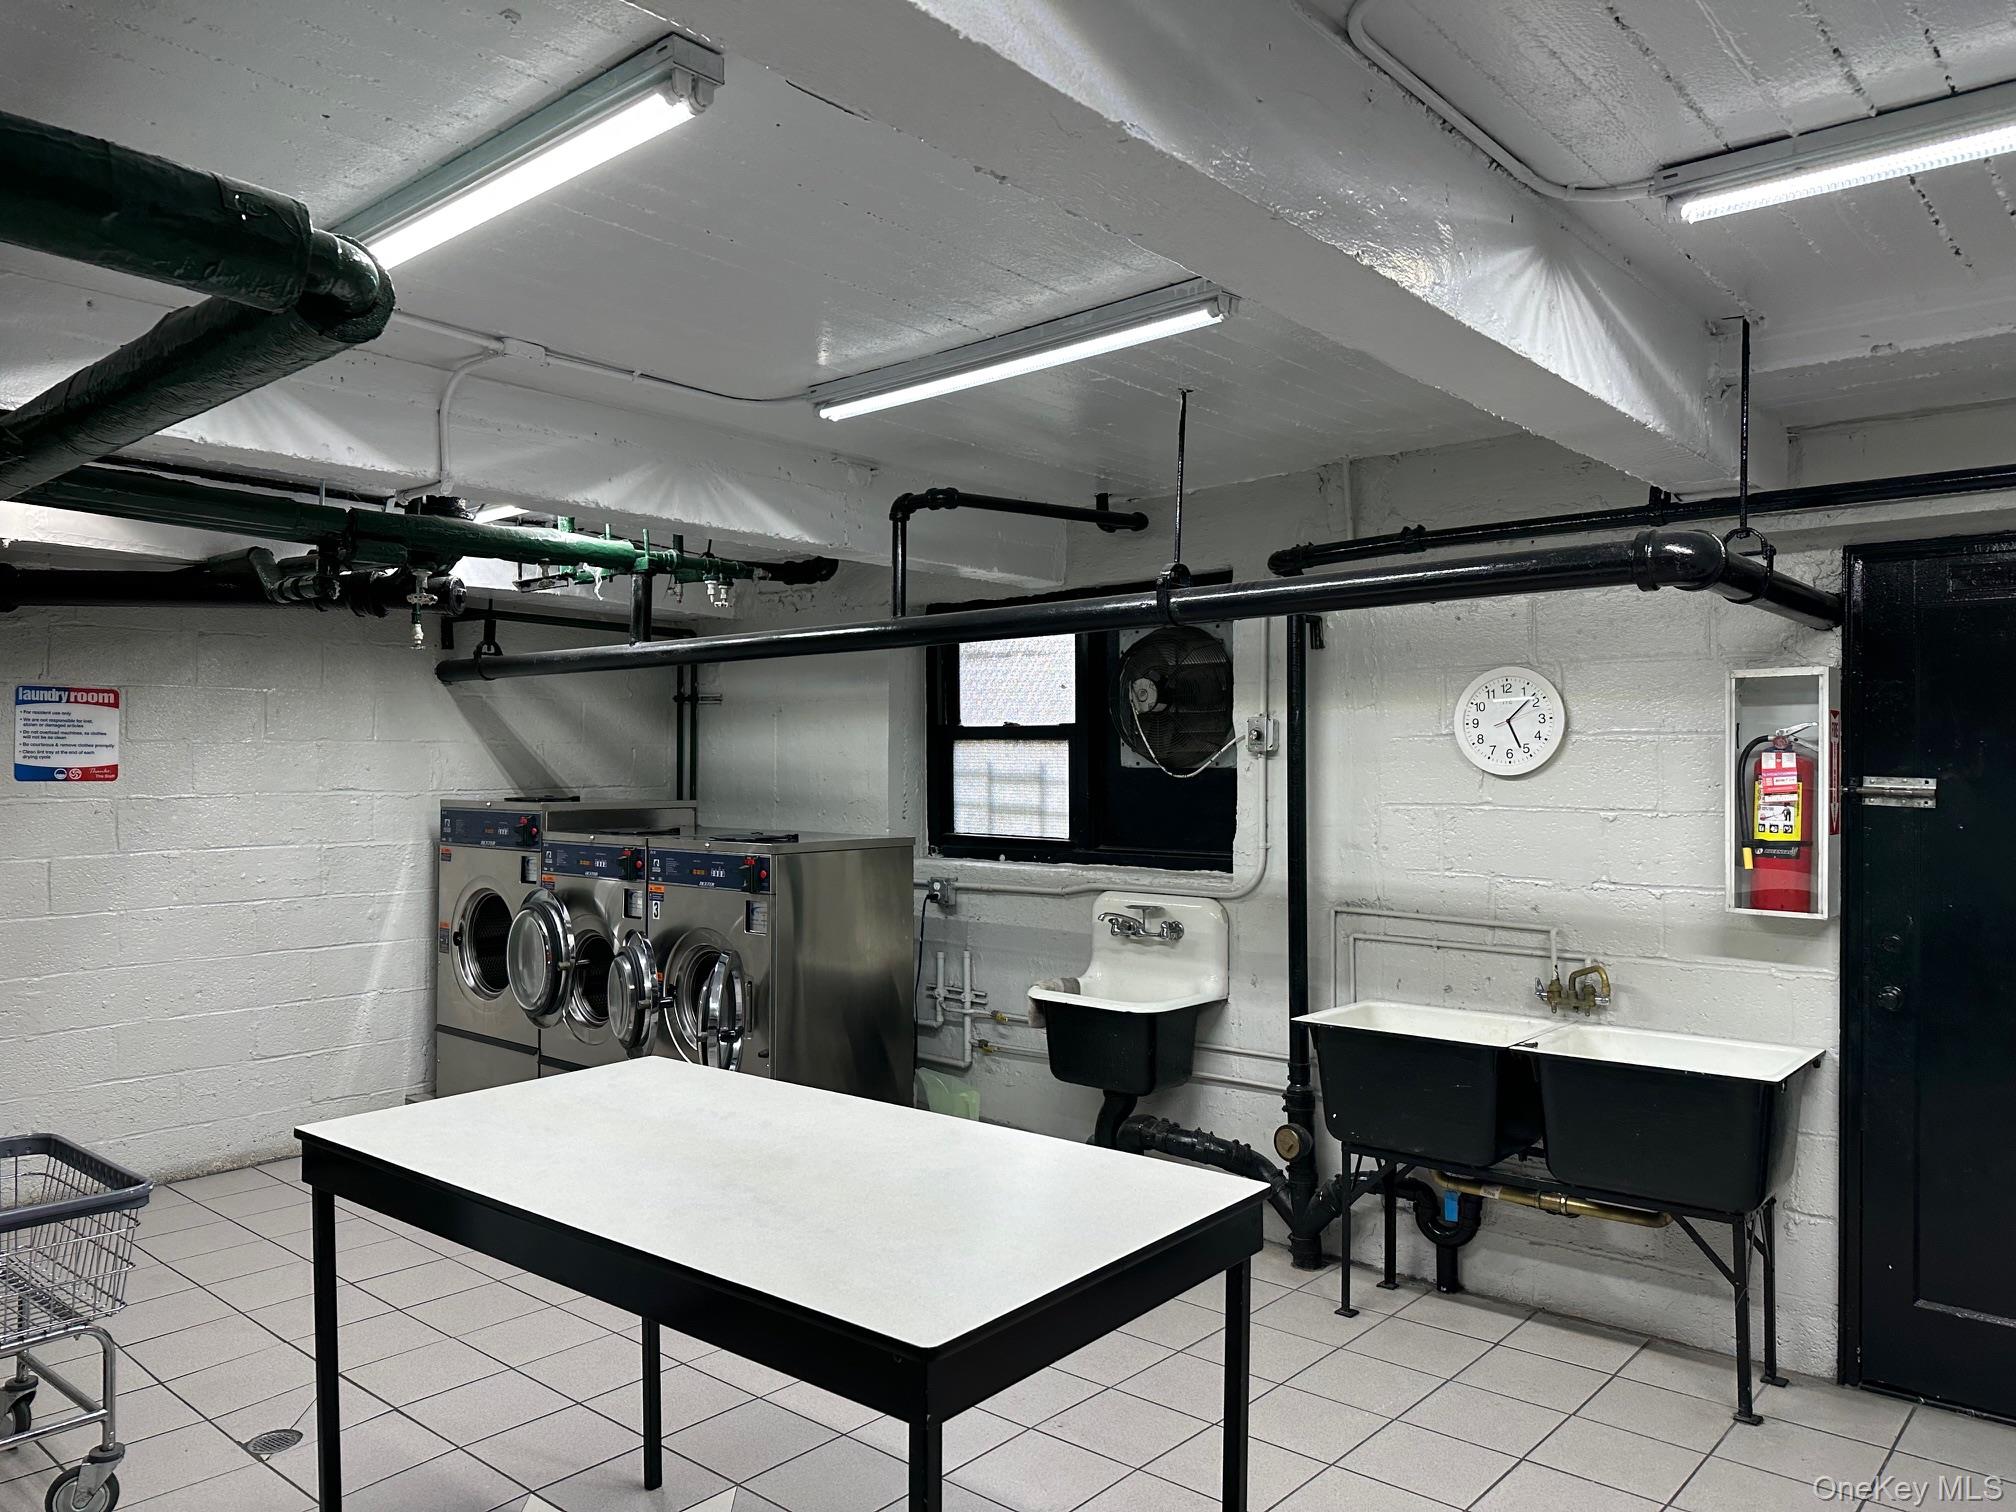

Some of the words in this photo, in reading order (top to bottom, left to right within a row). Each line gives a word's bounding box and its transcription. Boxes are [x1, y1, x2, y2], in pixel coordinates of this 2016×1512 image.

[1501, 683, 1512, 694] 12
[1521, 687, 1526, 696] 1
[18, 687, 69, 703] laundry
[69, 691, 115, 704] room
[1486, 689, 1495, 699] 11
[1474, 702, 1486, 712] 10
[1532, 698, 1540, 708] 2
[1472, 718, 1479, 728] 9
[1538, 713, 1546, 724] 3
[1477, 734, 1484, 744] 8
[1534, 730, 1542, 741] 4
[1489, 745, 1497, 755] 7
[1506, 748, 1513, 759] 6
[1522, 743, 1530, 754] 5
[654, 902, 659, 918] 3
